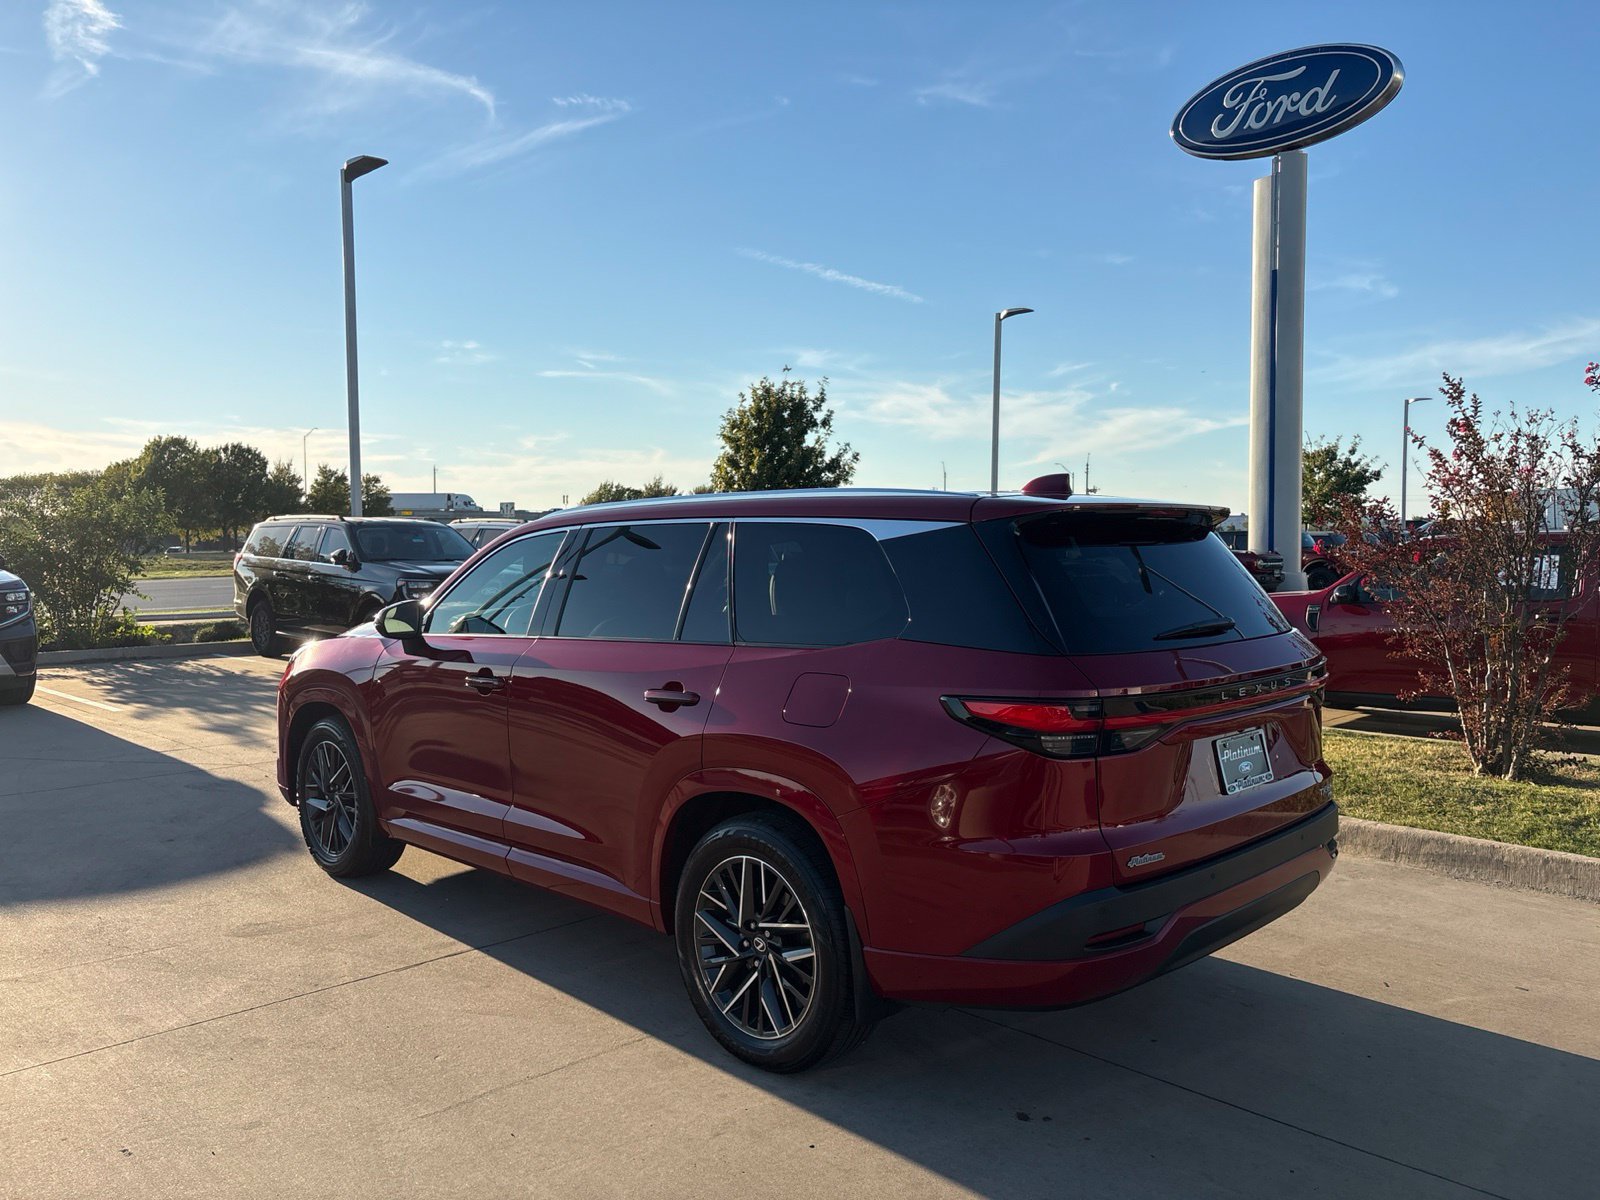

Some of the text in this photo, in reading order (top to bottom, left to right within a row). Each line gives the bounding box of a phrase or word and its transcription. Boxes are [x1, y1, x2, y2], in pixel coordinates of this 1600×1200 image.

[1211, 65, 1341, 138] Ford
[1221, 677, 1292, 700] LEXUS
[1221, 744, 1263, 762] Platinum
